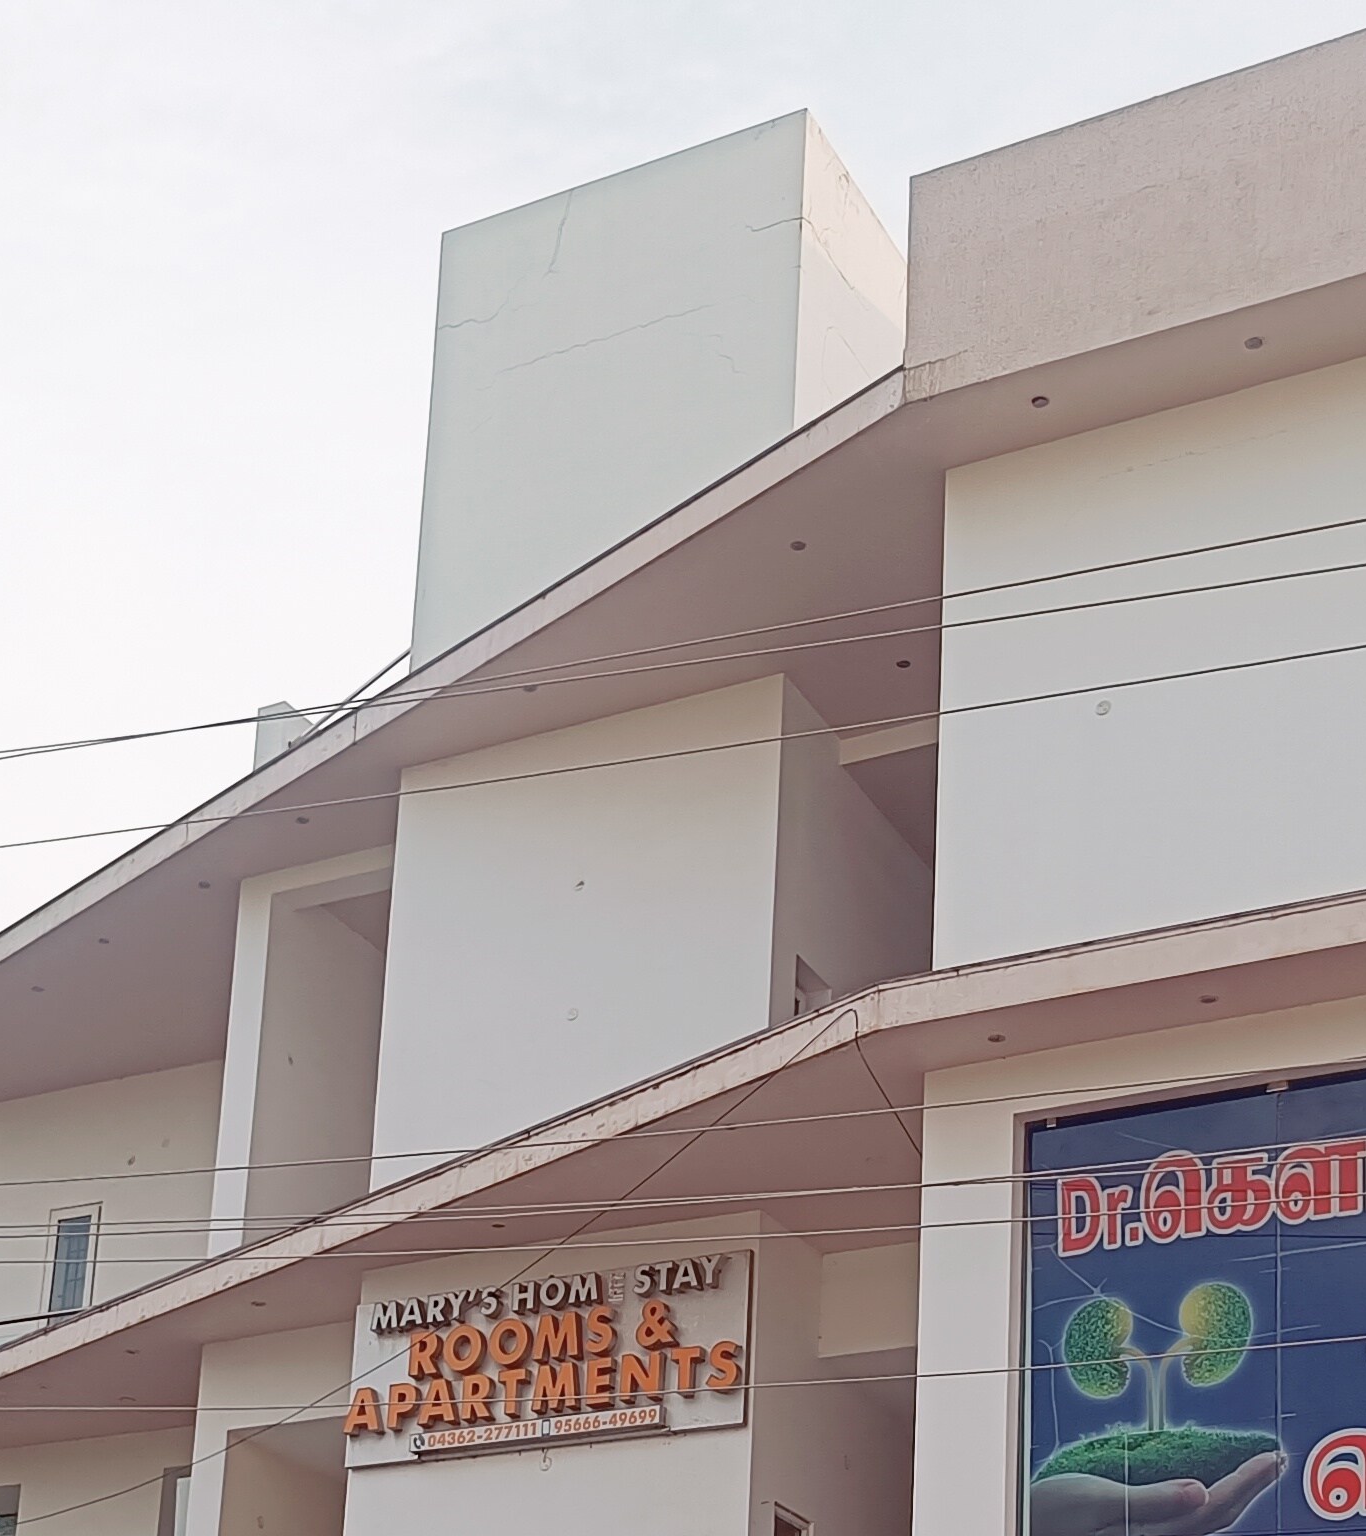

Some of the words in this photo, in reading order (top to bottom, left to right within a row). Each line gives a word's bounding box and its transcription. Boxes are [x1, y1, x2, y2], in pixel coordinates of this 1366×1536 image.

[371, 1286, 502, 1333] MARY'S
[633, 1253, 732, 1296] STAY
[408, 1306, 618, 1380] ROOMS
[636, 1300, 680, 1350] &
[343, 1340, 743, 1436] APARTMENTS
[428, 1421, 538, 1448] 04362-277111
[554, 1408, 658, 1434] 95666-49699
